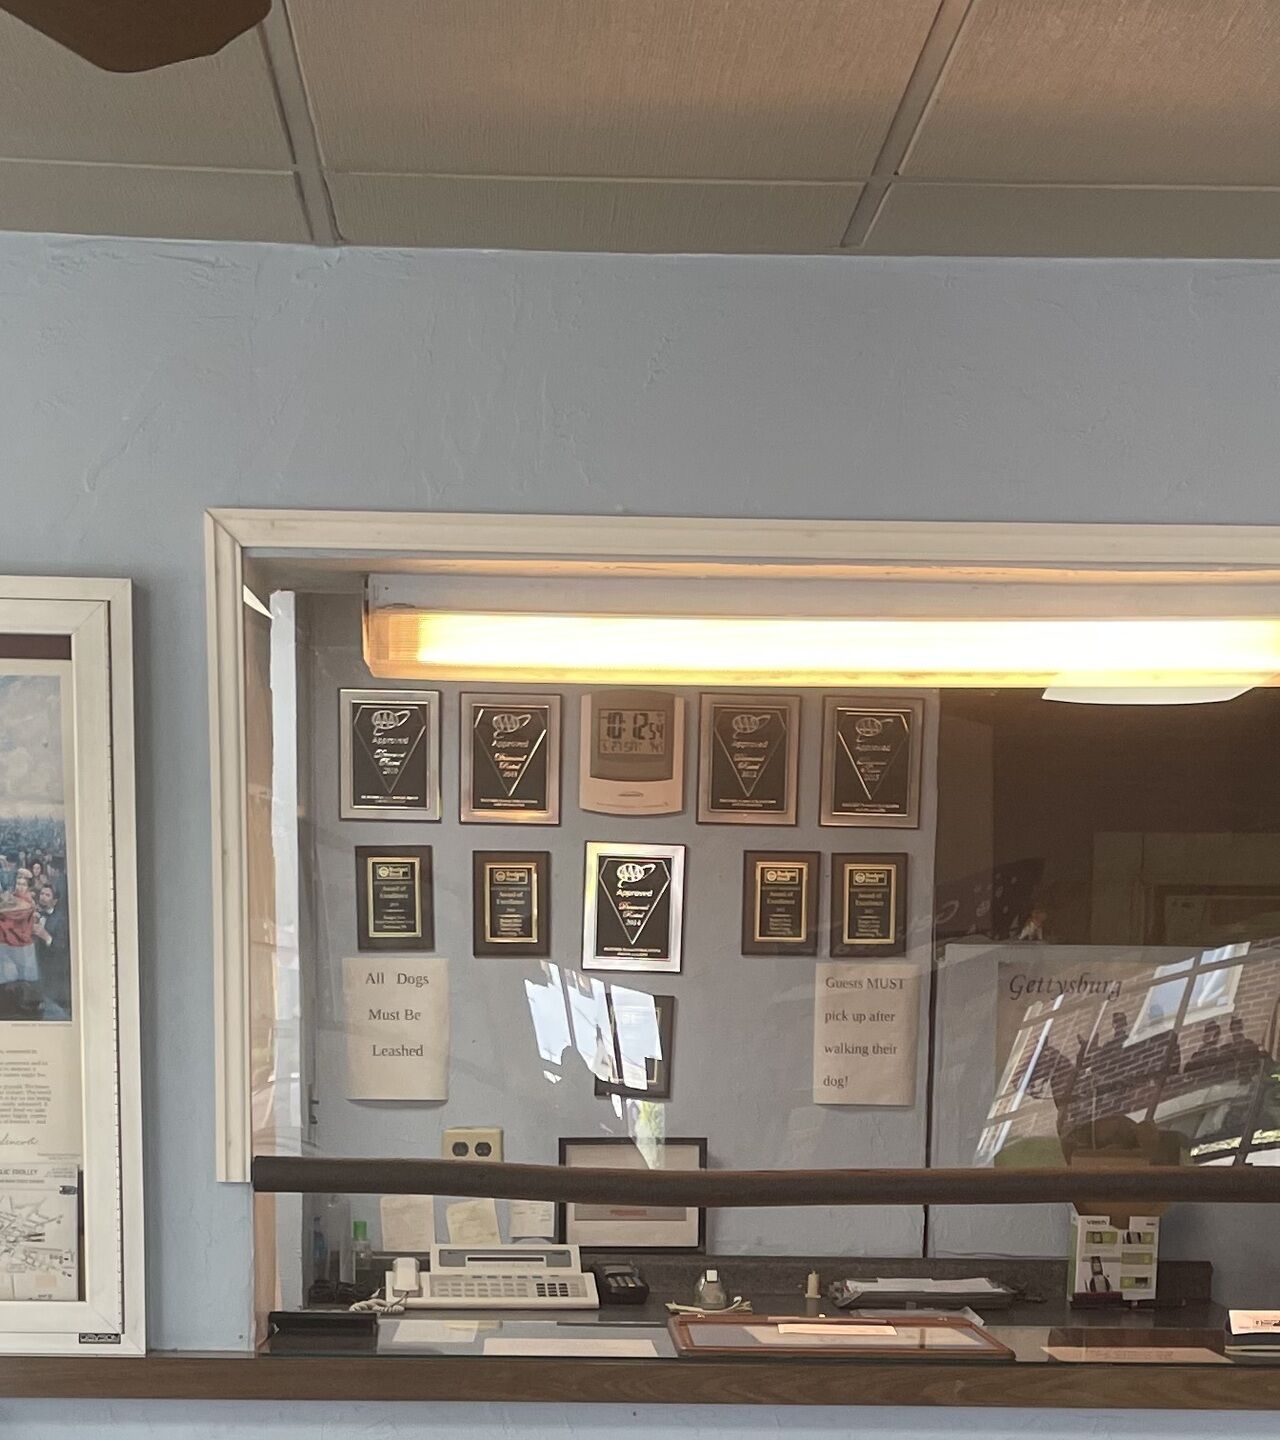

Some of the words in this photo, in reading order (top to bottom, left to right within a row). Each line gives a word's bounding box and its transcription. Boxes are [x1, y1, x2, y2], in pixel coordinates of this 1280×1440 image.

[615, 889, 653, 898] Approved
[365, 972, 385, 985] All
[396, 972, 430, 988] Dogs
[825, 976, 864, 989] Guests
[866, 978, 905, 990] MUST
[1008, 971, 1123, 1001] Gettysburg
[367, 1008, 400, 1021] Must
[404, 1009, 422, 1021] Be
[824, 1010, 849, 1024] pick
[851, 1012, 866, 1024] up
[869, 1010, 896, 1022] after
[371, 1044, 424, 1057] Leashed
[824, 1042, 870, 1057] walking
[871, 1043, 898, 1055] their
[822, 1074, 849, 1088] dog!
